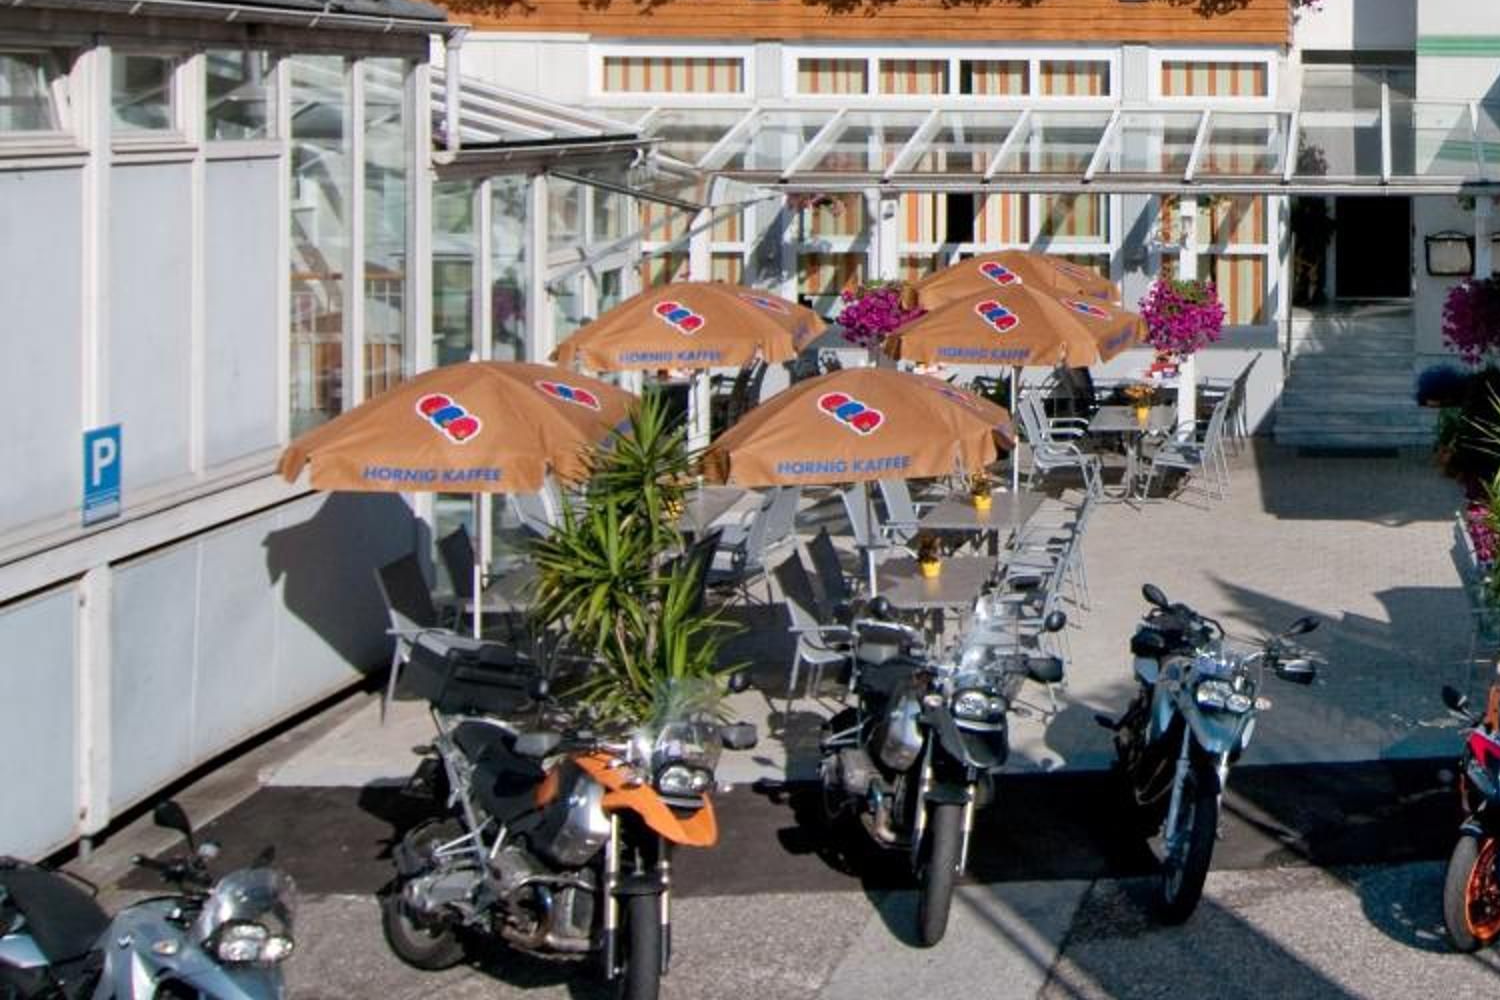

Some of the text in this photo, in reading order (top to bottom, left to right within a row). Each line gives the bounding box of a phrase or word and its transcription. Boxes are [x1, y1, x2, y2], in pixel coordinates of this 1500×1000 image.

[92, 437, 117, 487] P
[776, 456, 848, 476] HORNIG
[361, 465, 503, 482] HORNIG KAFFEE
